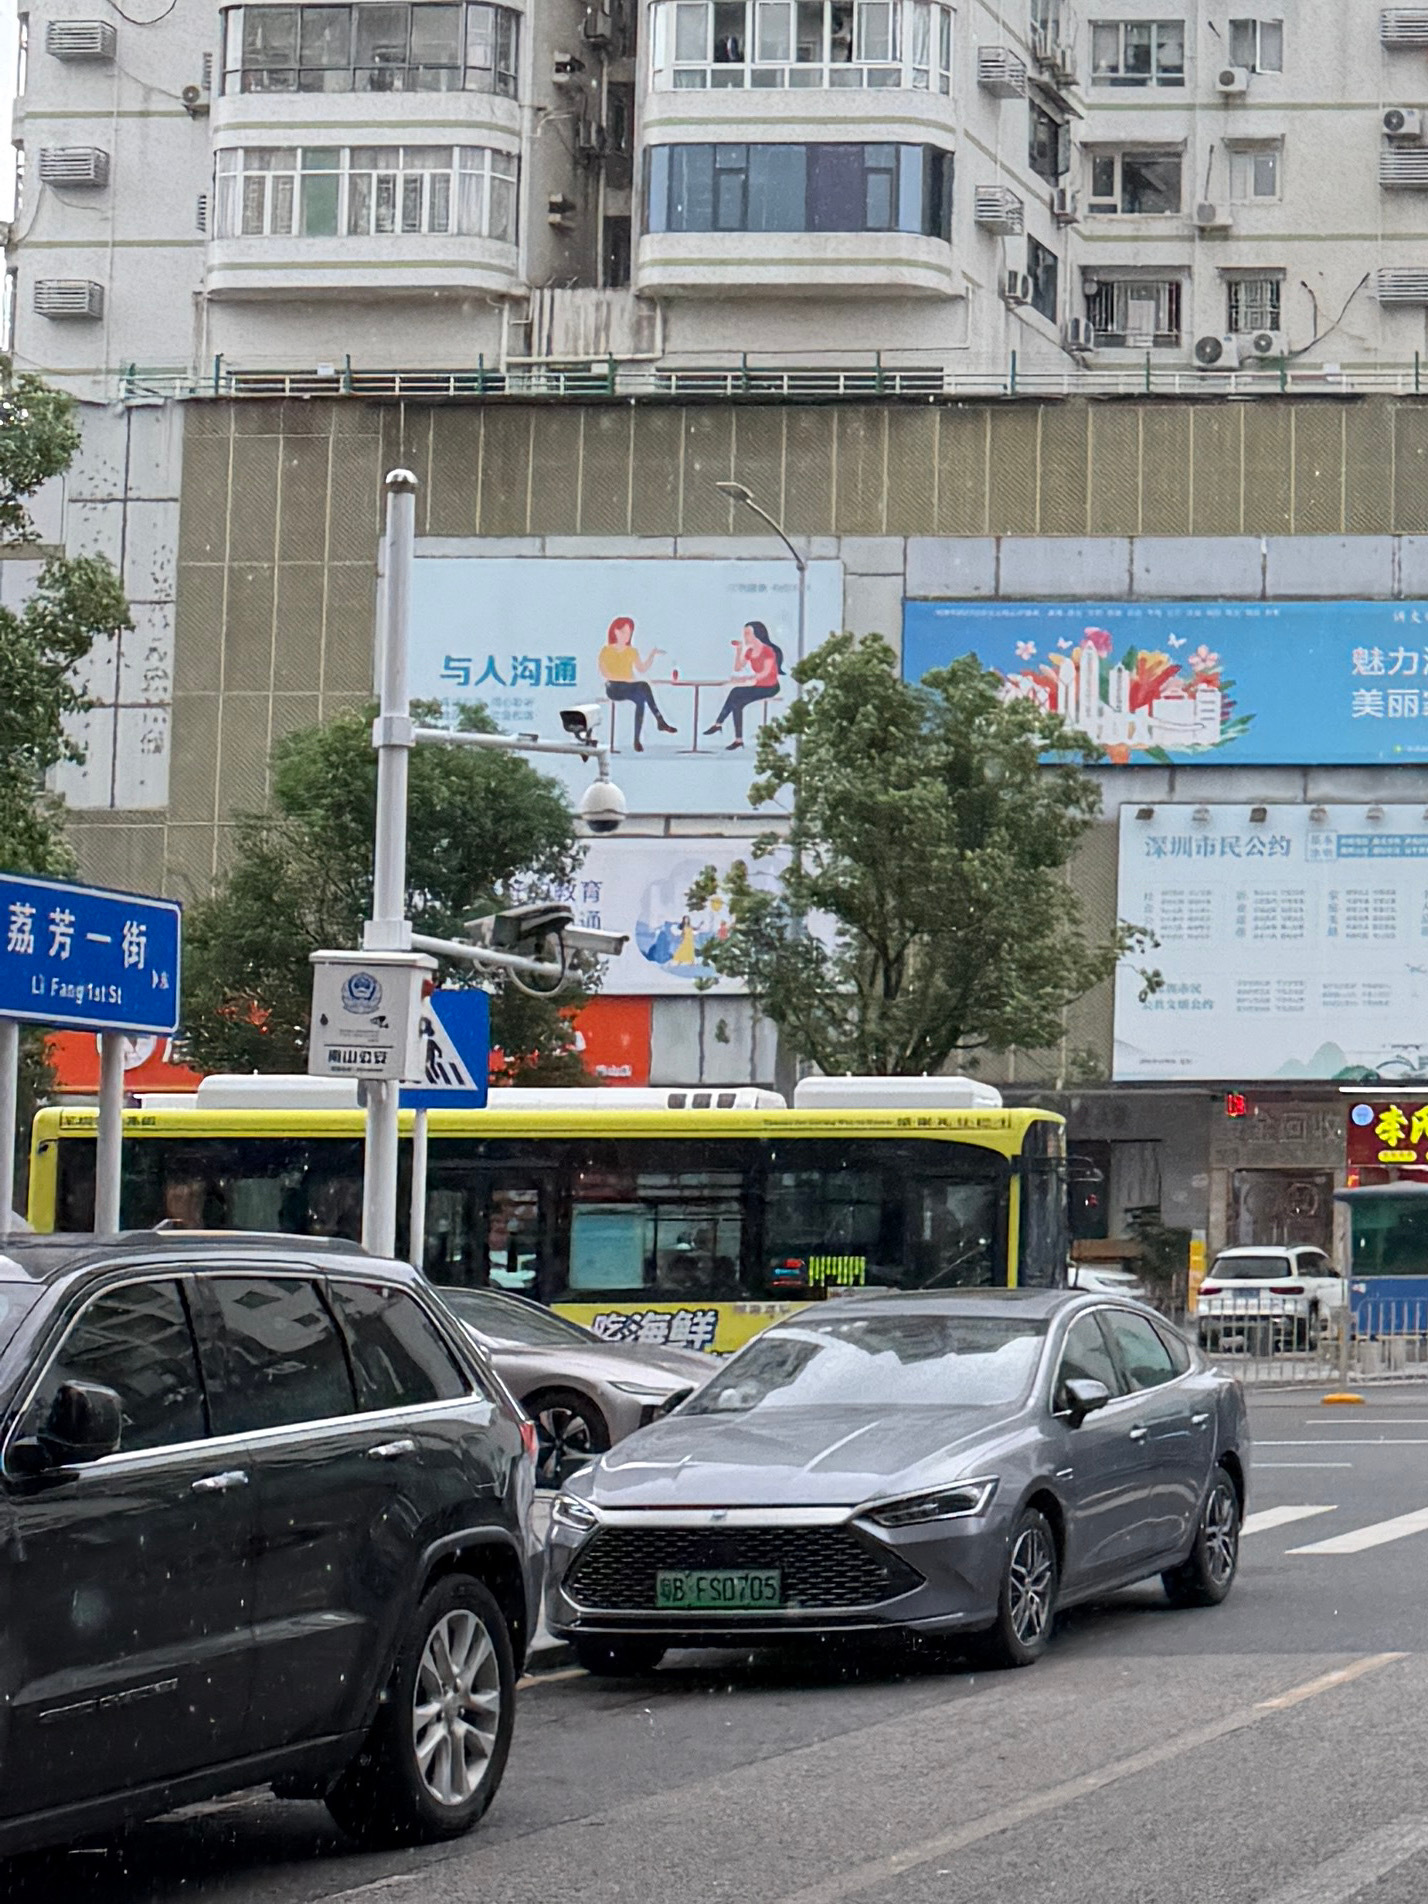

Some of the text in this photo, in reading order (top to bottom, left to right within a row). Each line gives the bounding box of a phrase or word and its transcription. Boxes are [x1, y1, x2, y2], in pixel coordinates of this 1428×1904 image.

[439, 655, 578, 688] 与人沟通
[1145, 835, 1291, 859] 深圳市民公约
[7, 902, 147, 970] 荔芳一街
[51, 977, 84, 1005] Fang
[328, 1049, 388, 1064] 南山公安
